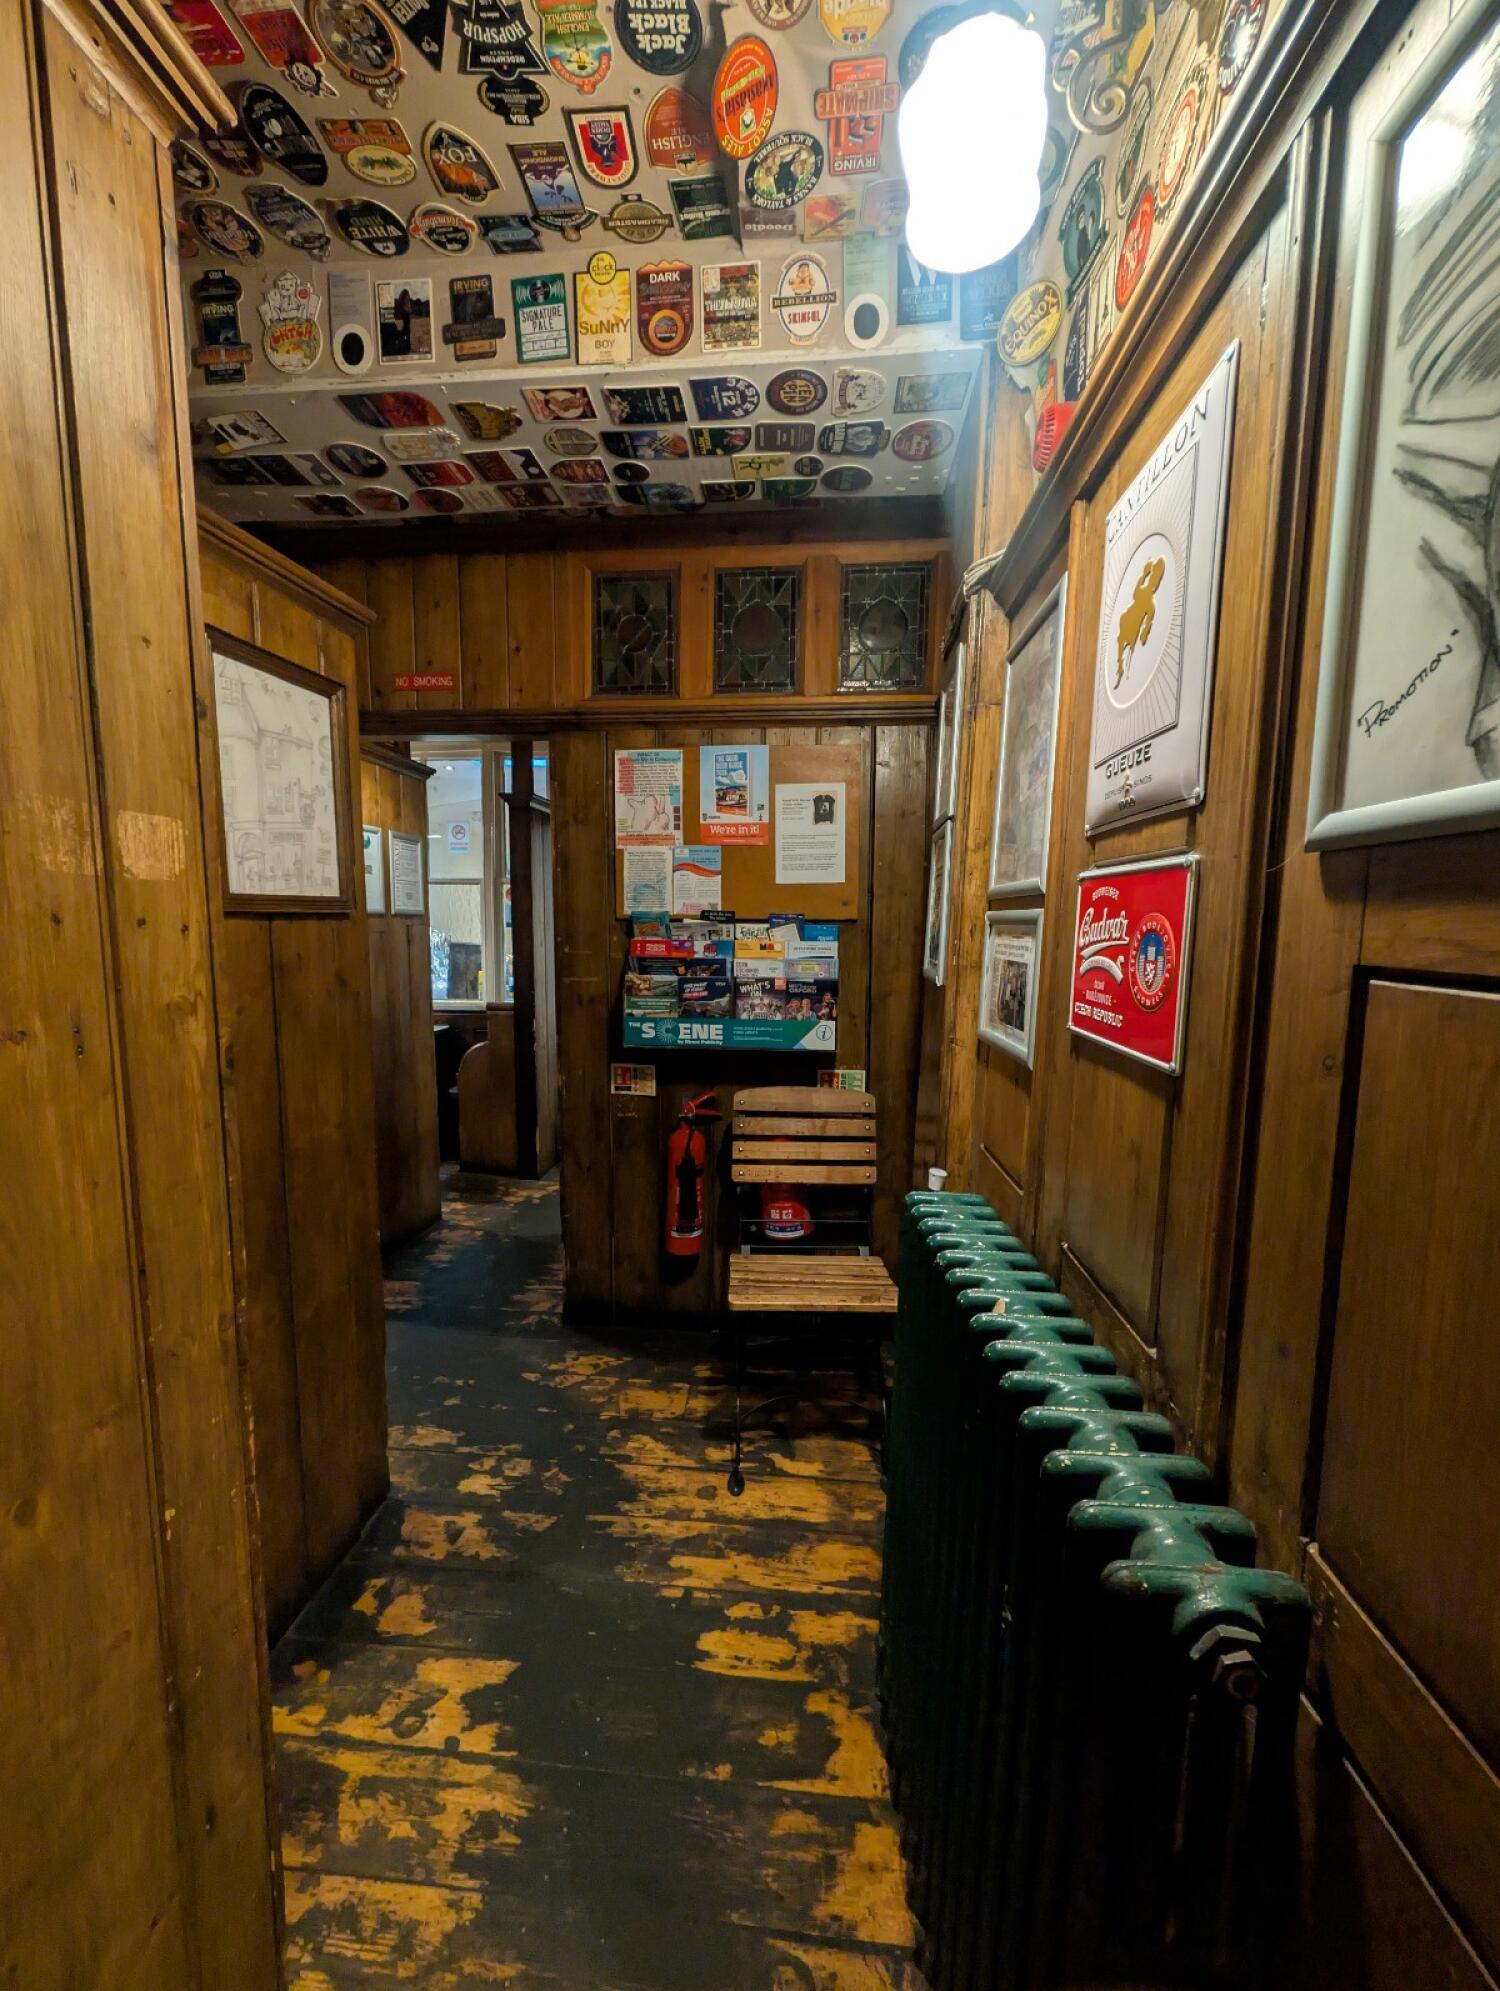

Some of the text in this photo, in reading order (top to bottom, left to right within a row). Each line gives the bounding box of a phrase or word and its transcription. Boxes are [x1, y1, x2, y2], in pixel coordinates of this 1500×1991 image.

[463, 18, 528, 45] HOPSPUR
[628, 13, 691, 35] Black
[636, 35, 687, 54] Jack
[652, 131, 712, 151] ENGLISH
[791, 133, 814, 147] BLACK
[438, 145, 480, 166] FOX
[834, 155, 877, 171] IRVING
[350, 225, 403, 240] WHITE
[453, 278, 489, 291] IRVING
[649, 271, 681, 284] DARK
[202, 303, 235, 315] IRVING
[520, 305, 563, 323] SIGNATURE
[531, 318, 554, 332] PALE
[1004, 293, 1058, 352] EQUINOX
[594, 339, 616, 349] BOY
[395, 675, 453, 687] NO SMOKING
[1105, 743, 1152, 780] GUEUZE
[709, 824, 760, 834] We're in it!
[1078, 906, 1130, 946] Budvar
[739, 980, 771, 994] WHAT'S
[1092, 1007, 1124, 1029] REPUBLIC
